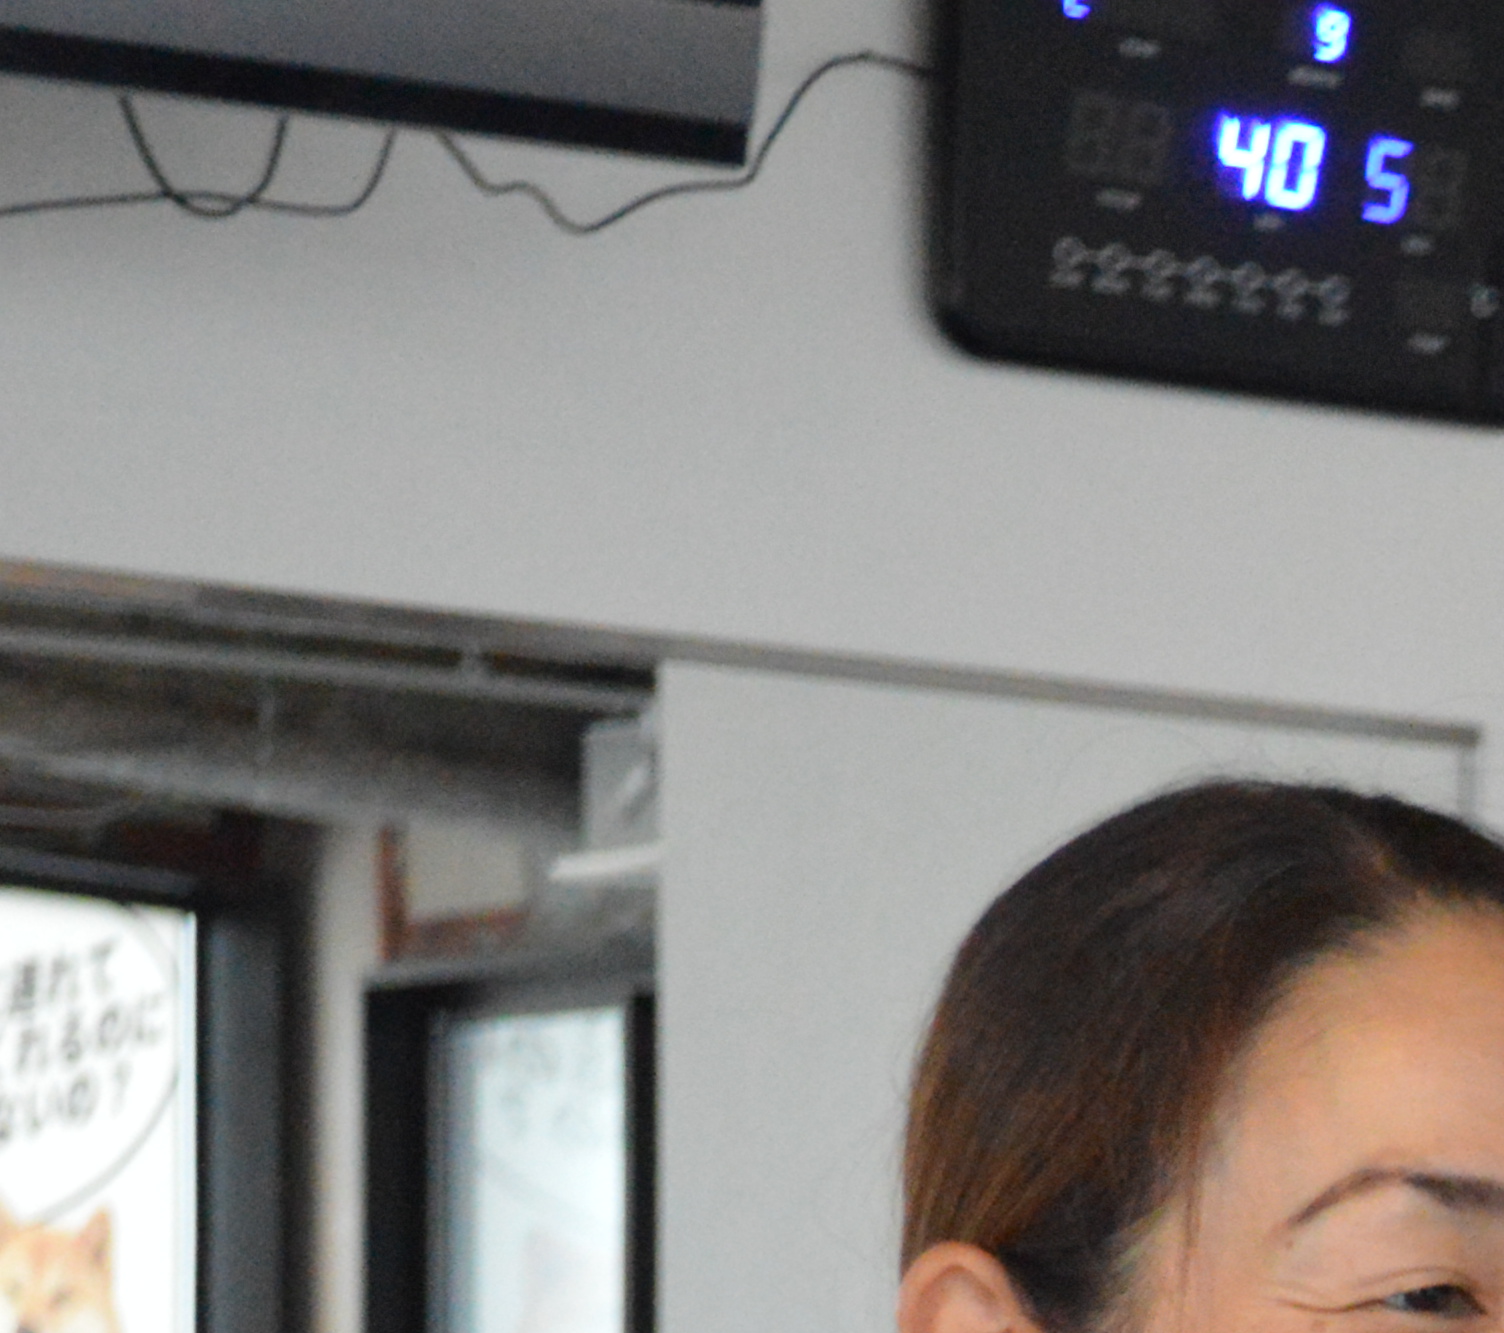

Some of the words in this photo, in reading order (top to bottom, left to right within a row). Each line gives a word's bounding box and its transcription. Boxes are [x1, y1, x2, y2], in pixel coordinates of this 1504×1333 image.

[1312, 2, 1352, 64] 9
[1214, 109, 1328, 213] 40
[1360, 131, 1416, 226] 5
